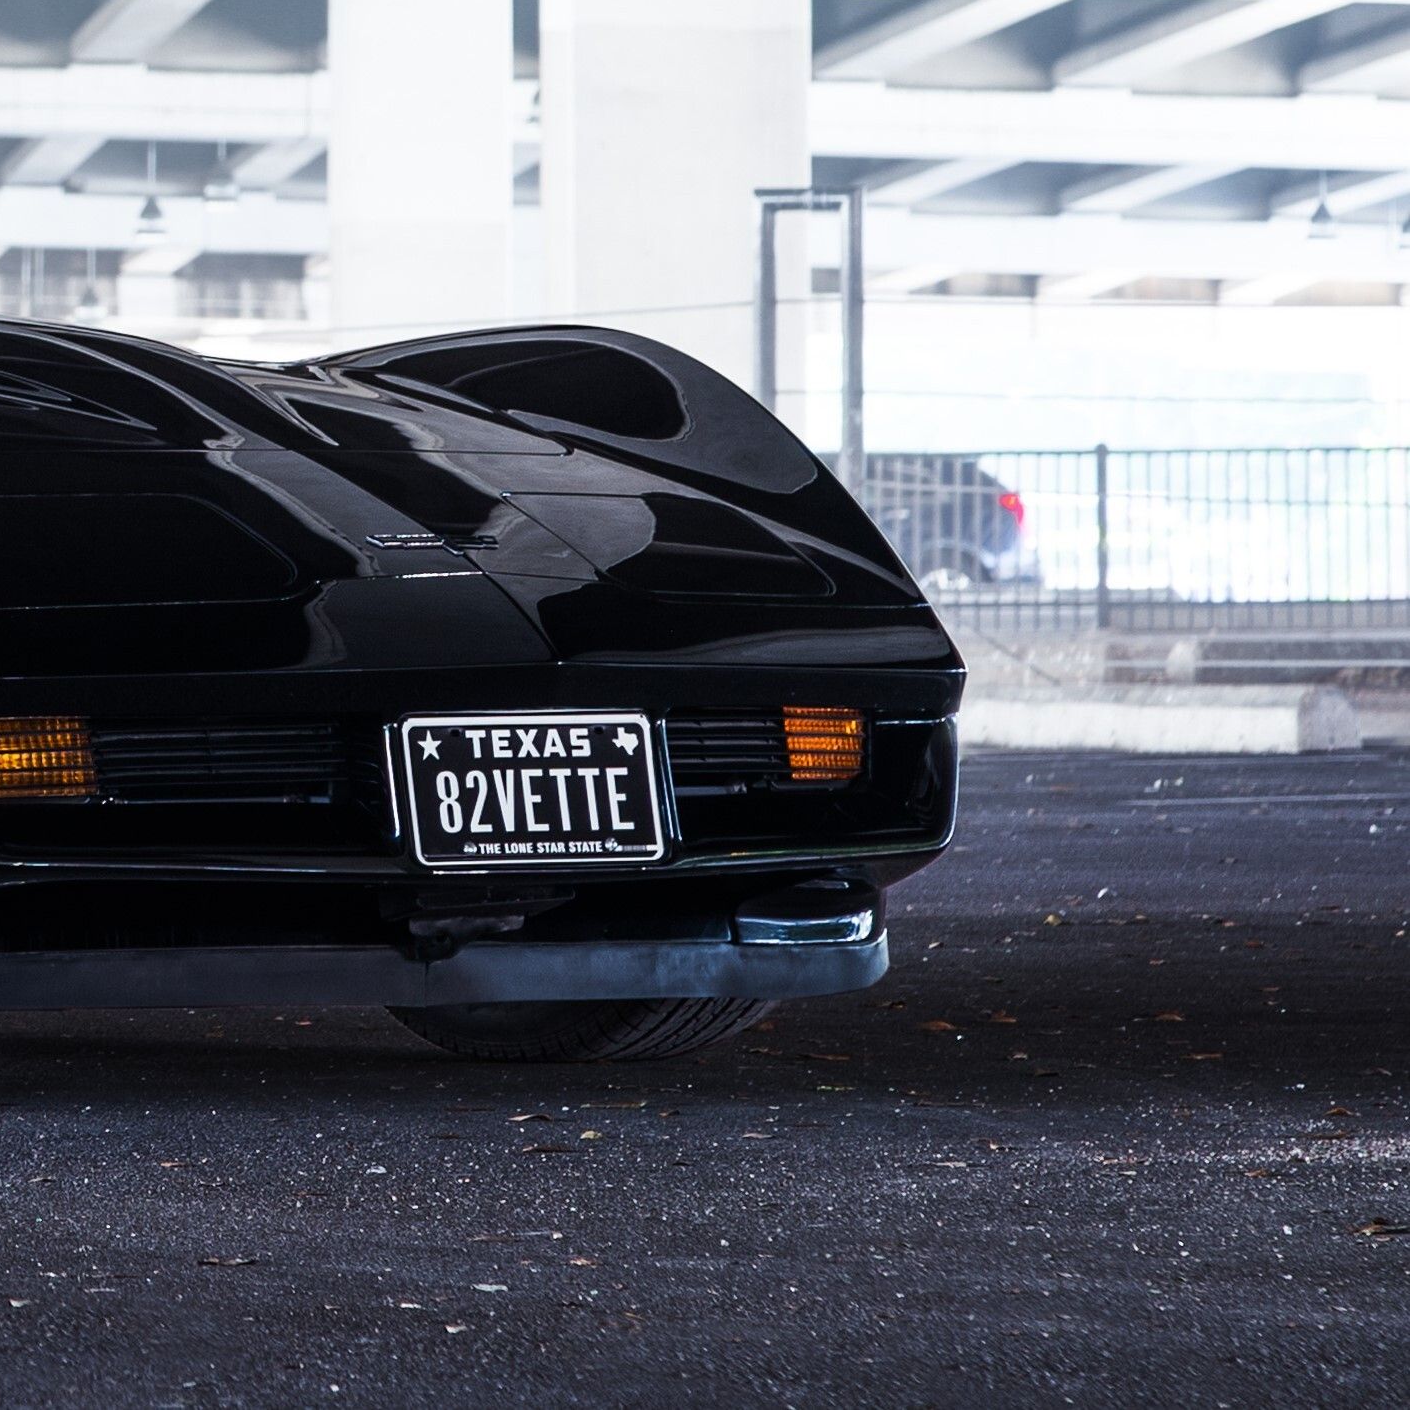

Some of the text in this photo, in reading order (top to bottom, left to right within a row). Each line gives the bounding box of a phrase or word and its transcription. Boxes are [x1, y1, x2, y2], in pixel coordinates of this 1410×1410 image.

[465, 728, 592, 759] TEXAS
[436, 767, 635, 834] 82VETTE
[479, 841, 603, 855] THE LONE STAR STATE
